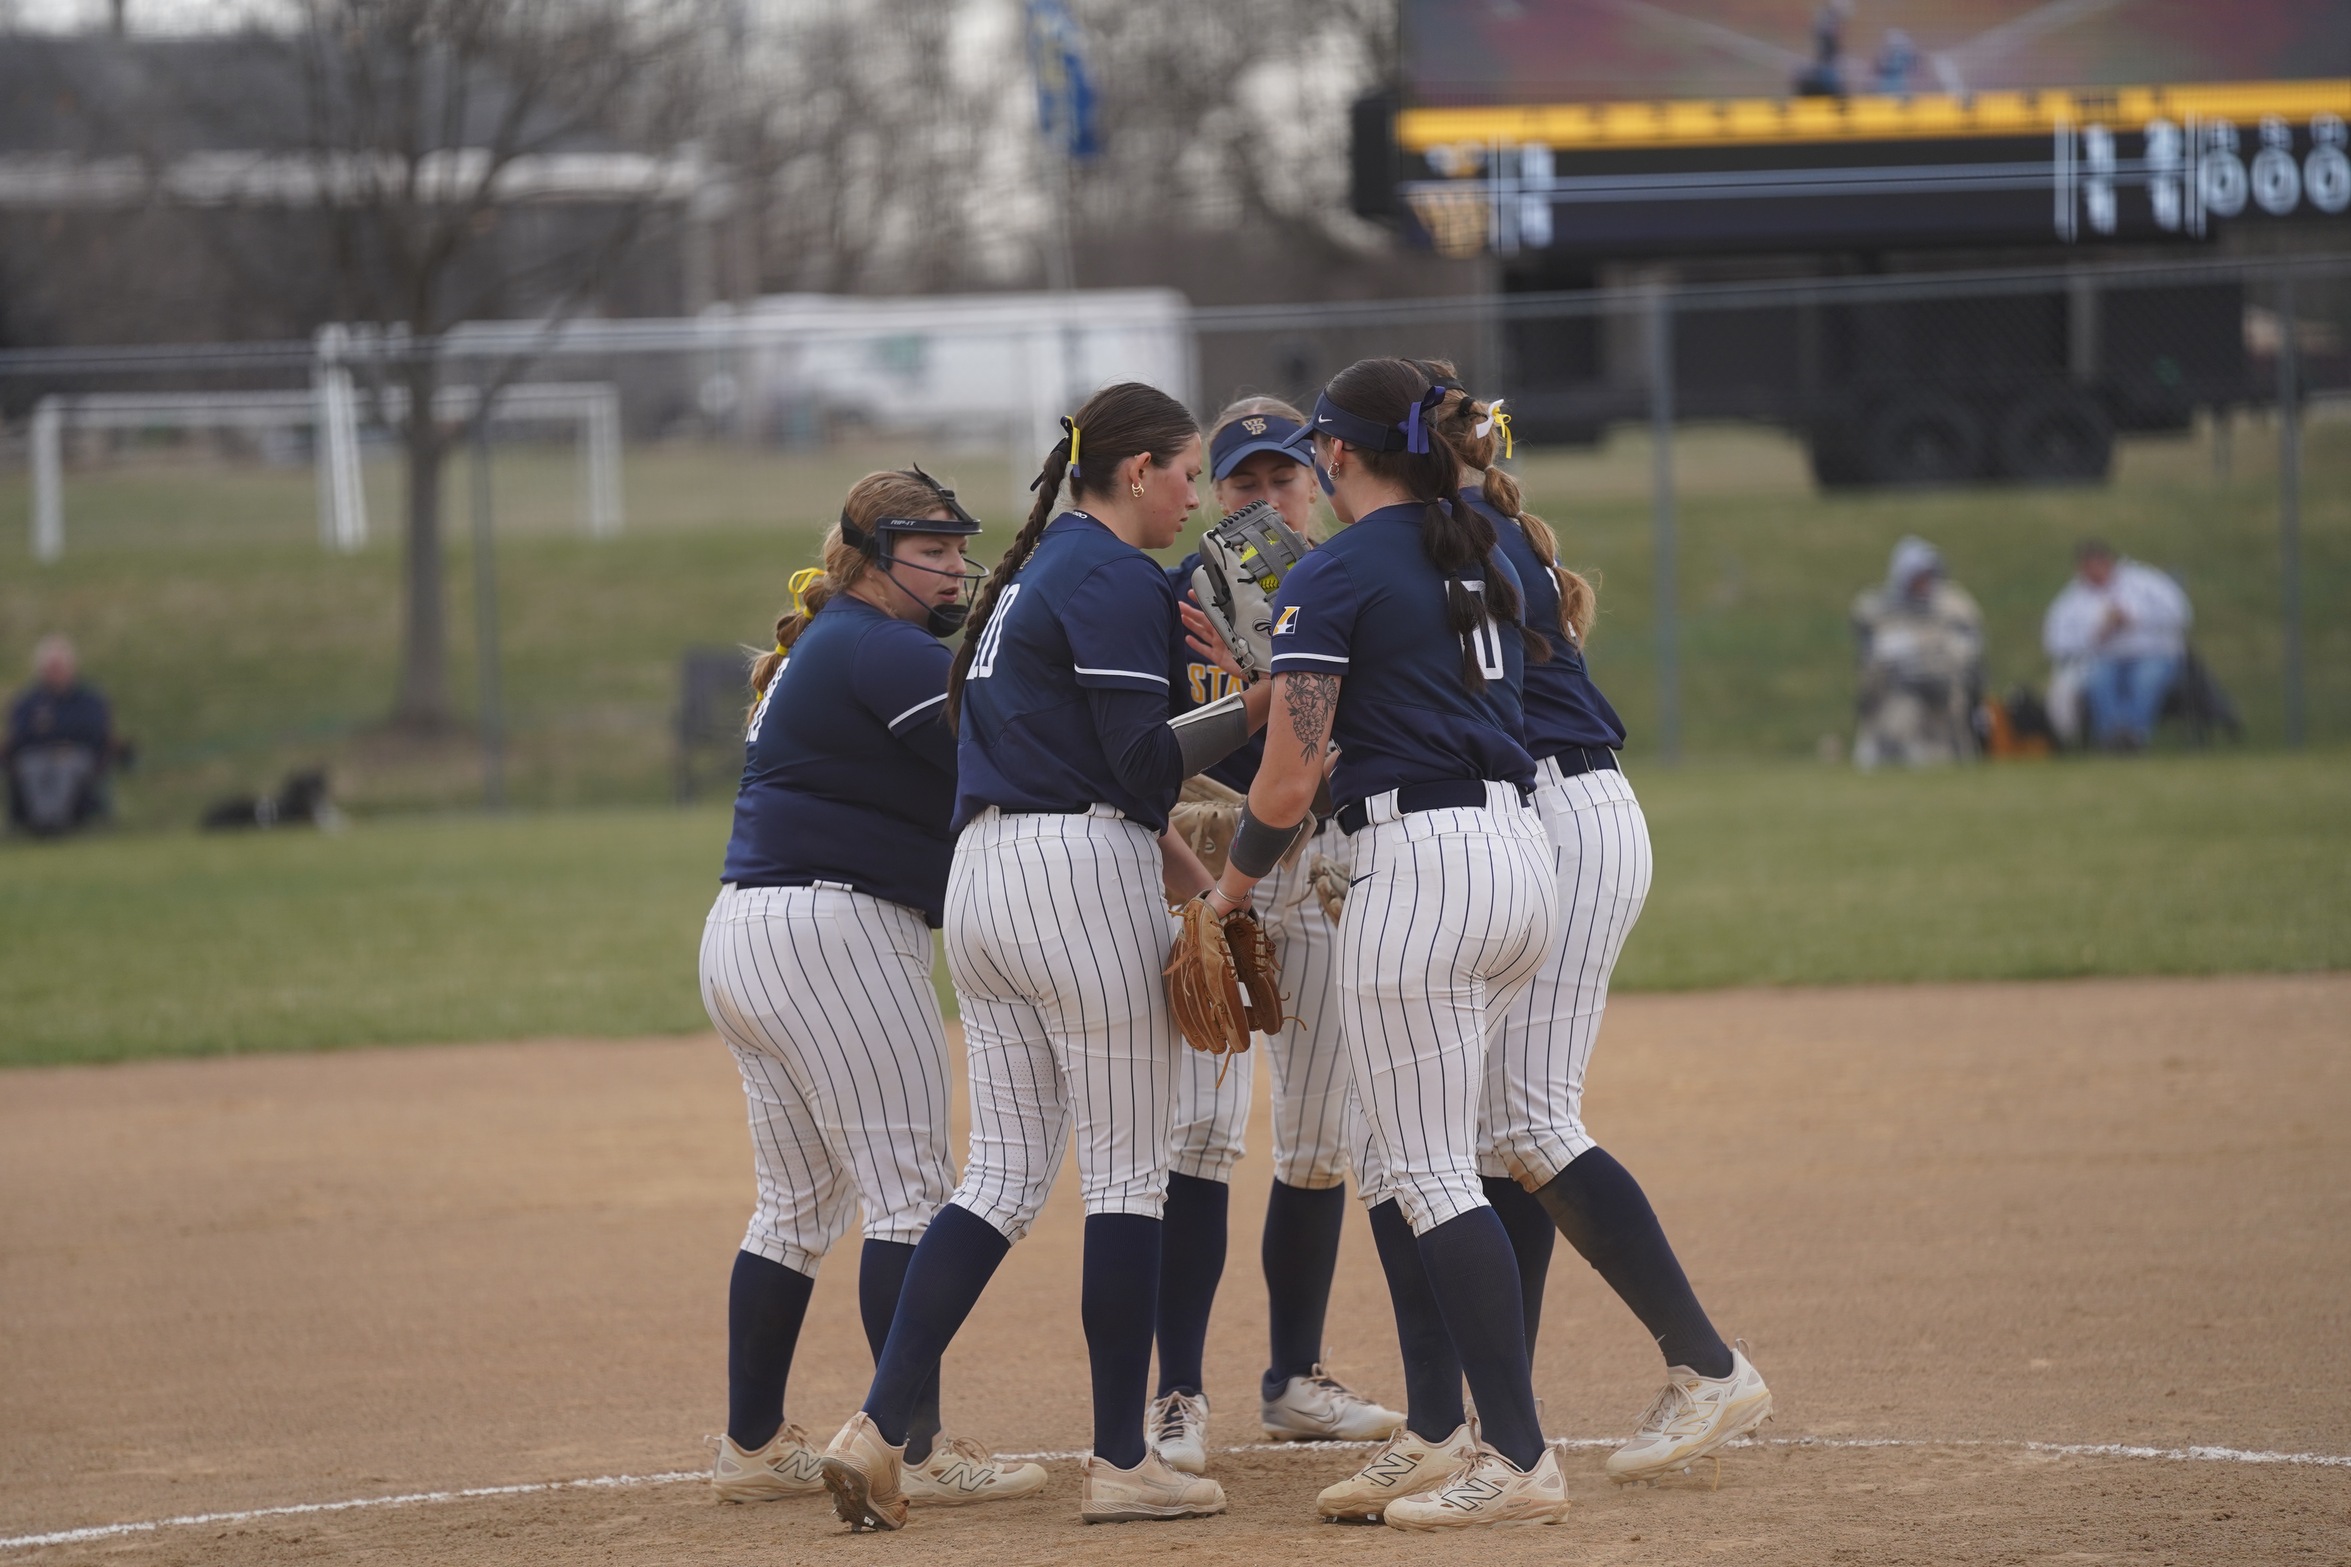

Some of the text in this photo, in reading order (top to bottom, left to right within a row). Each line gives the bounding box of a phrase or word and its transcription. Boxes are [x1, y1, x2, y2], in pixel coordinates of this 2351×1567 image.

[937, 1462, 995, 1492] N
[1361, 1452, 1418, 1488] N
[1440, 1477, 1503, 1512] N
